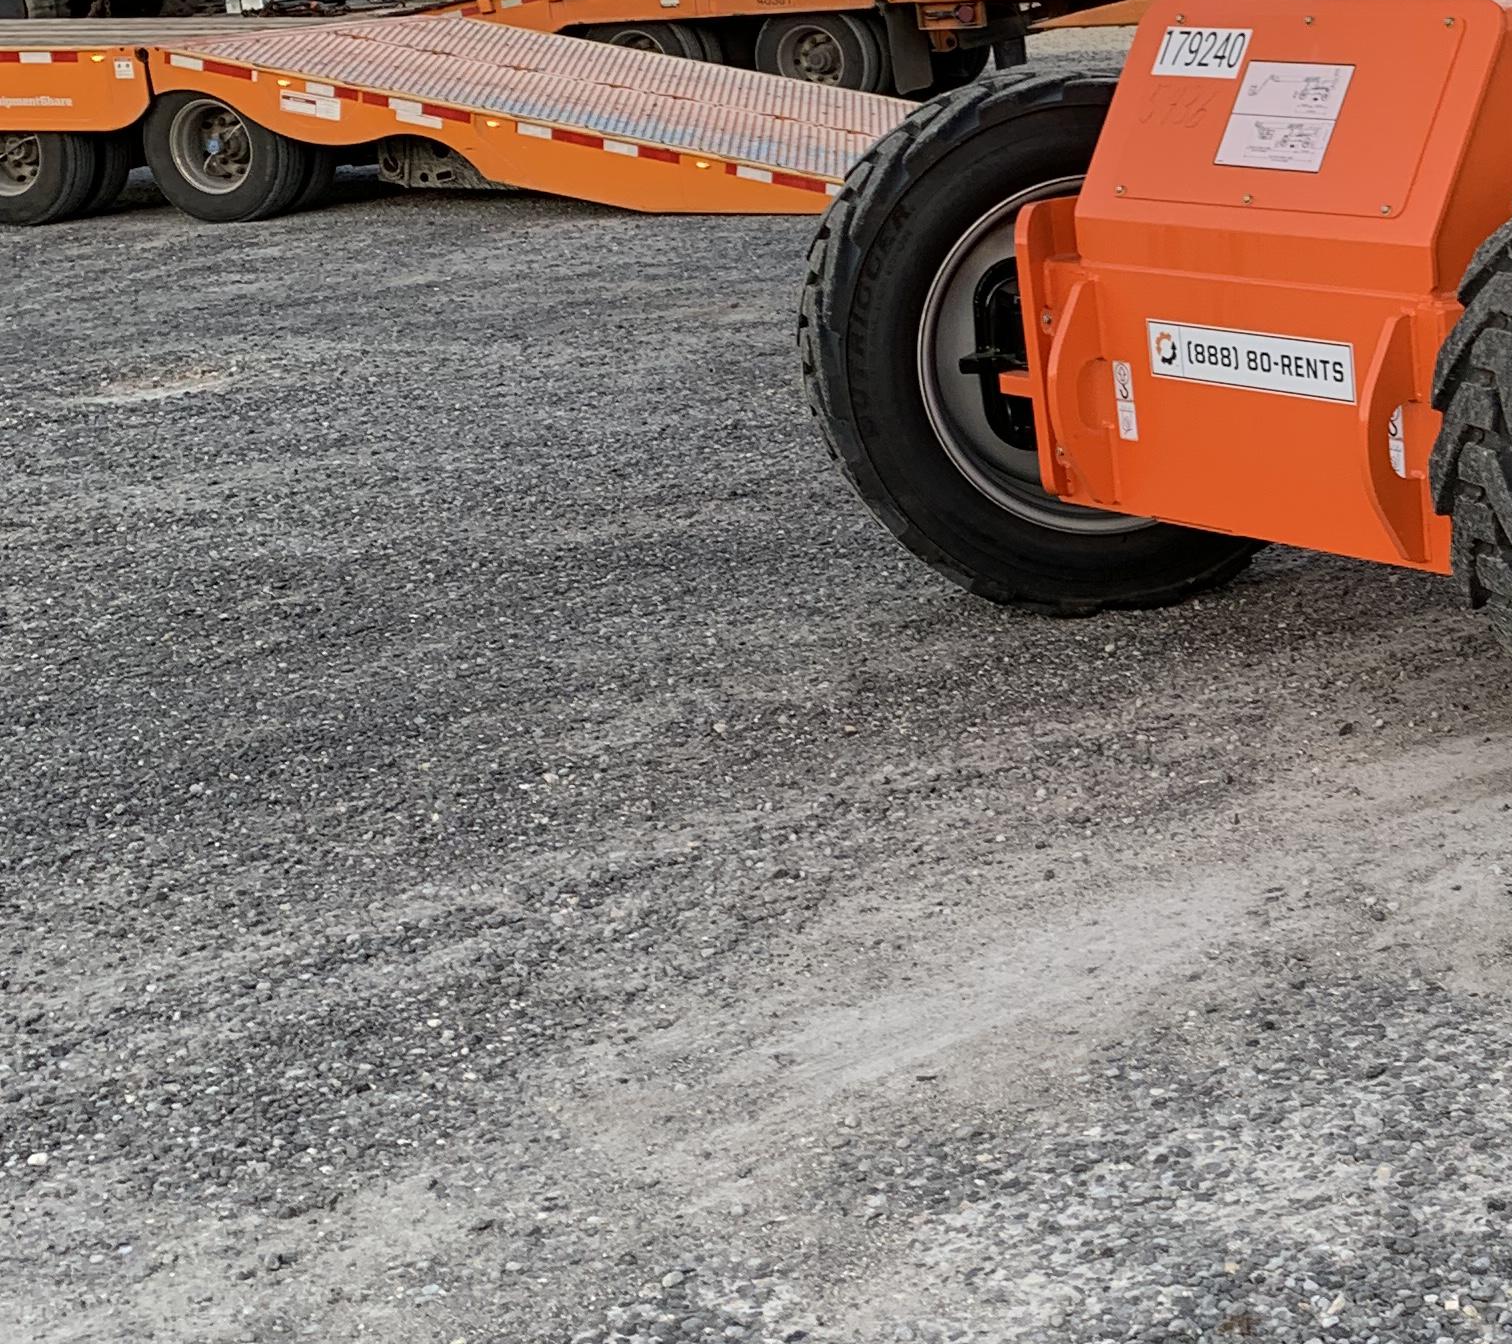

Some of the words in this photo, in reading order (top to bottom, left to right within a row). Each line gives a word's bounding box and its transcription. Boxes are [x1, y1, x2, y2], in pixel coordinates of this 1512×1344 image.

[1158, 30, 1247, 69] 179240
[1186, 340, 1239, 371] (888)
[1246, 350, 1345, 383] 80-RENTS
